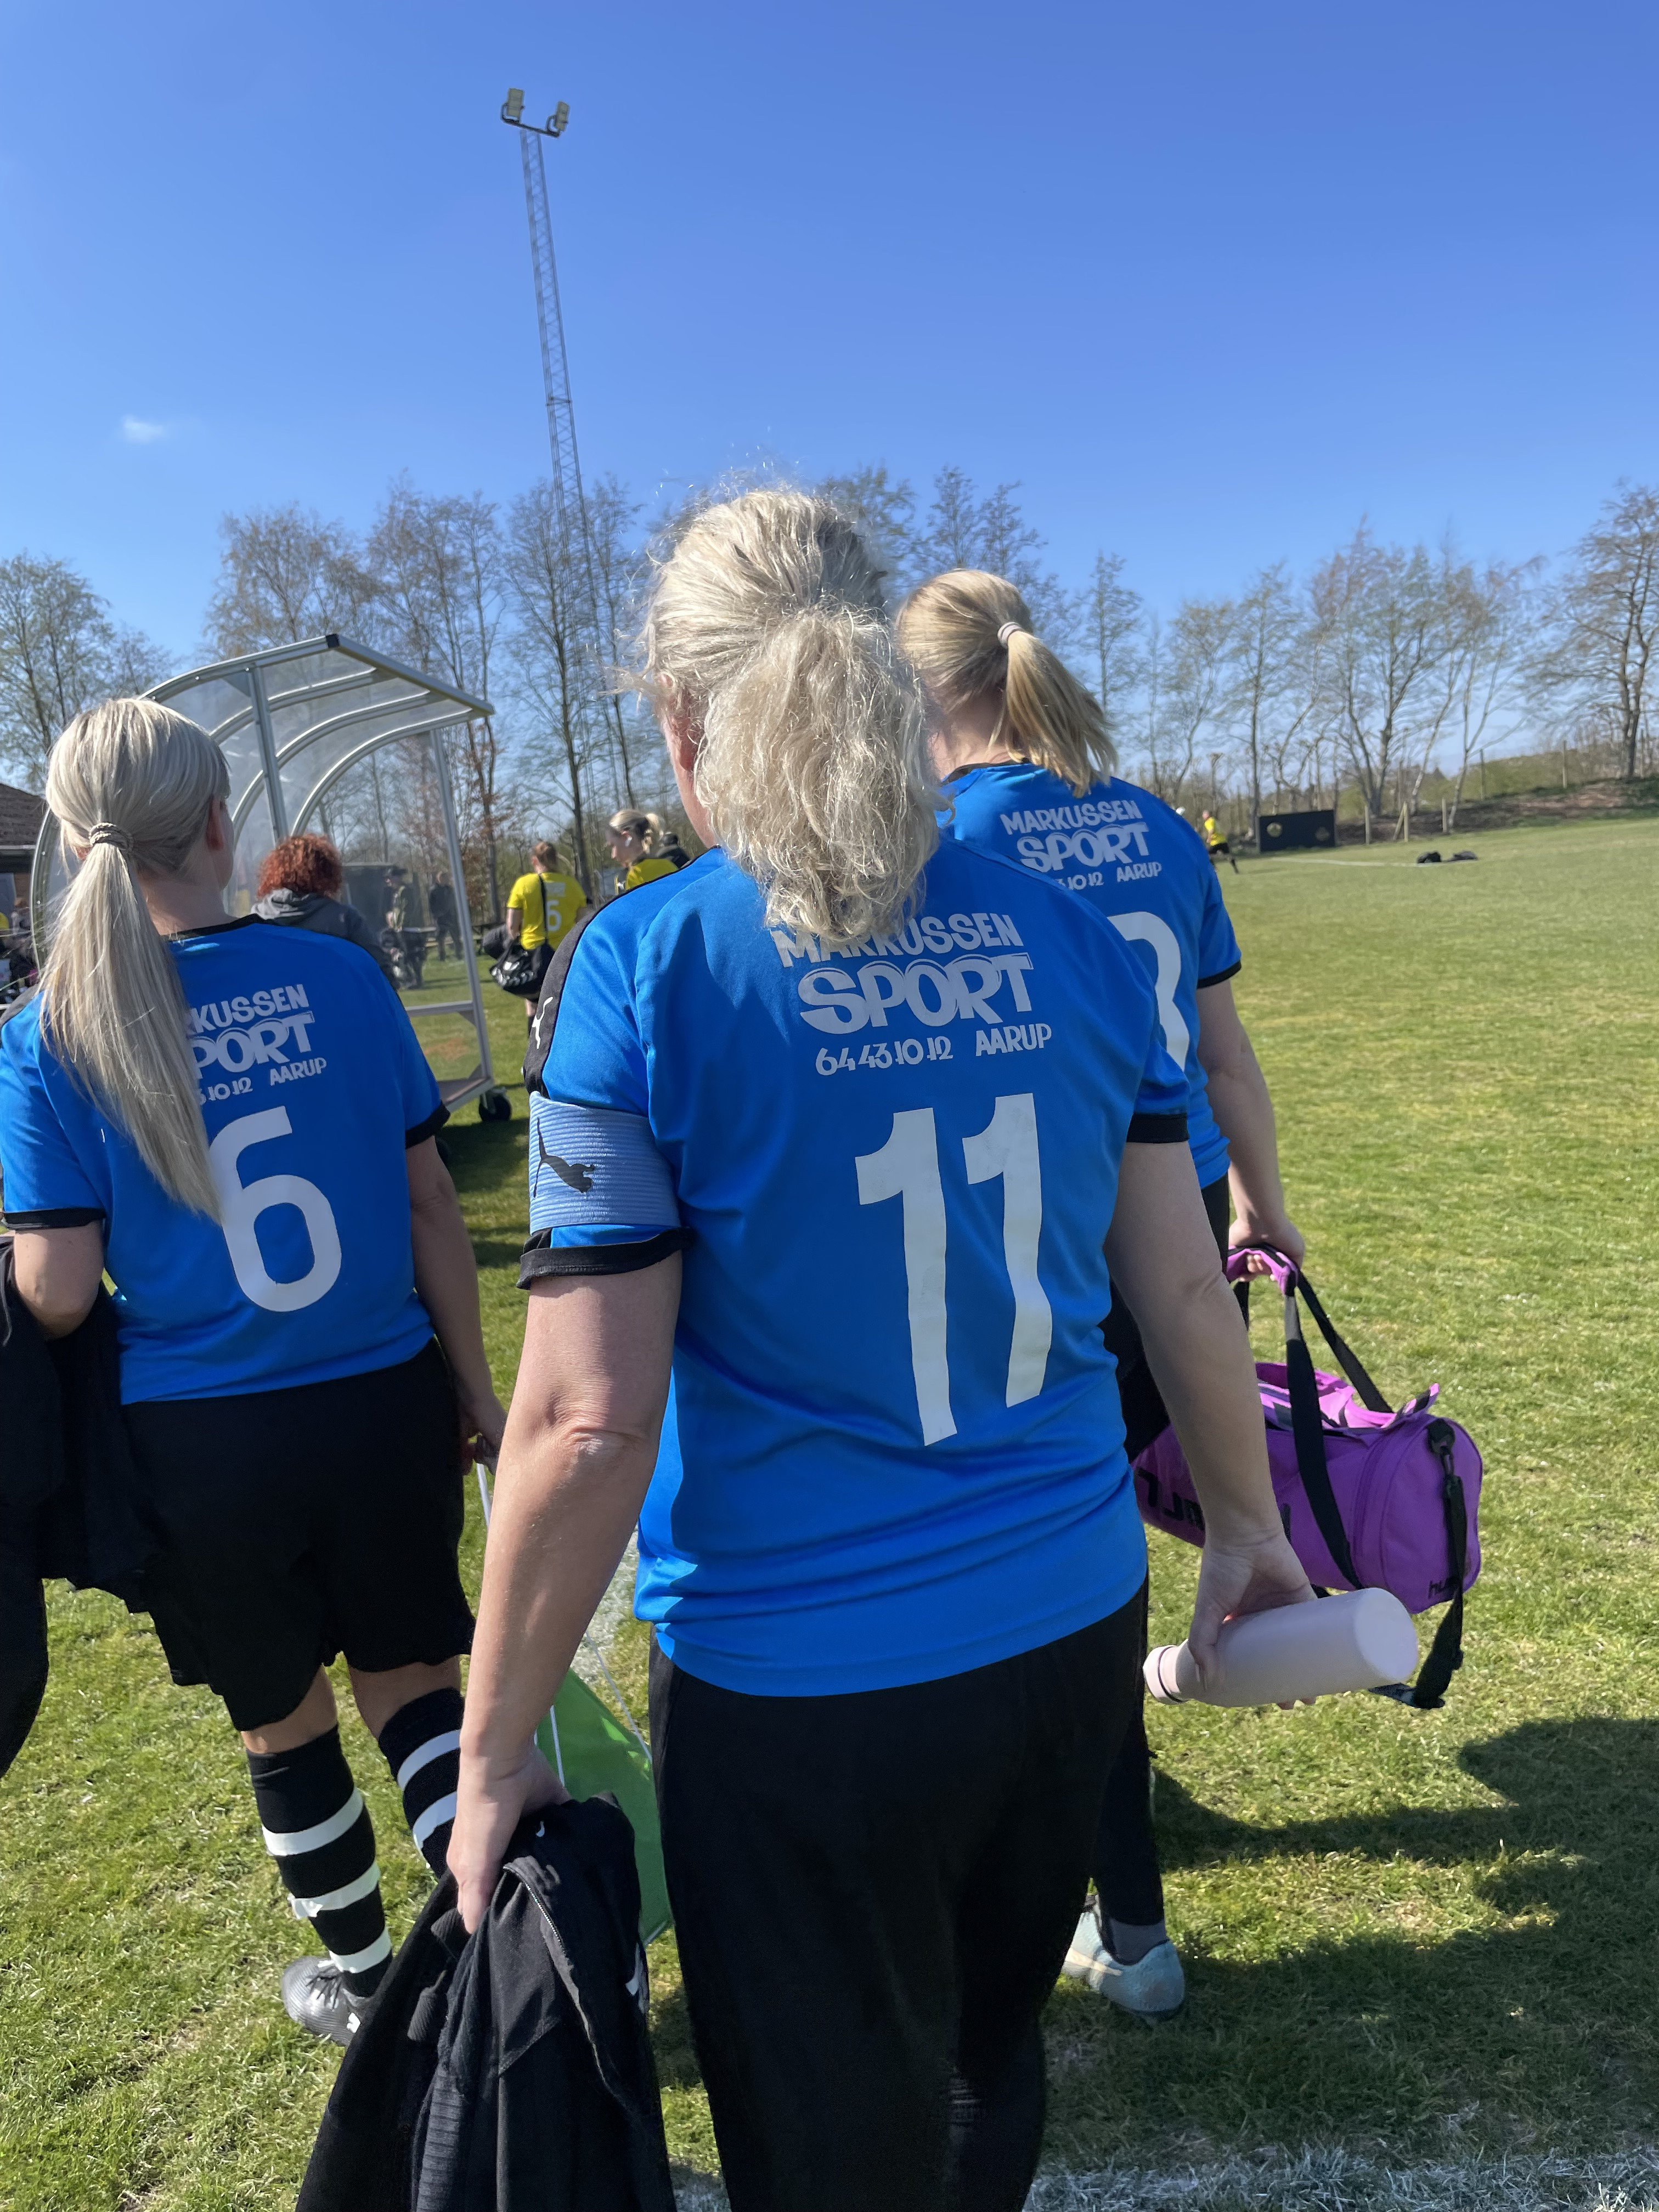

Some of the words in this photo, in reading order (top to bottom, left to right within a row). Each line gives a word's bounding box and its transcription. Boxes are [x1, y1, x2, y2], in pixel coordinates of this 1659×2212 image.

[1000, 799, 1143, 835] MARKUSSEN
[1017, 822, 1150, 873] SPORT
[1116, 861, 1162, 882] AARUP
[187, 984, 309, 1035] KUSSEN
[798, 952, 1034, 1034] SPORT
[975, 1024, 1052, 1056] AARUP
[270, 1057, 326, 1086] AARUP
[209, 1106, 342, 1312] 6
[855, 1093, 1052, 1446] 11
